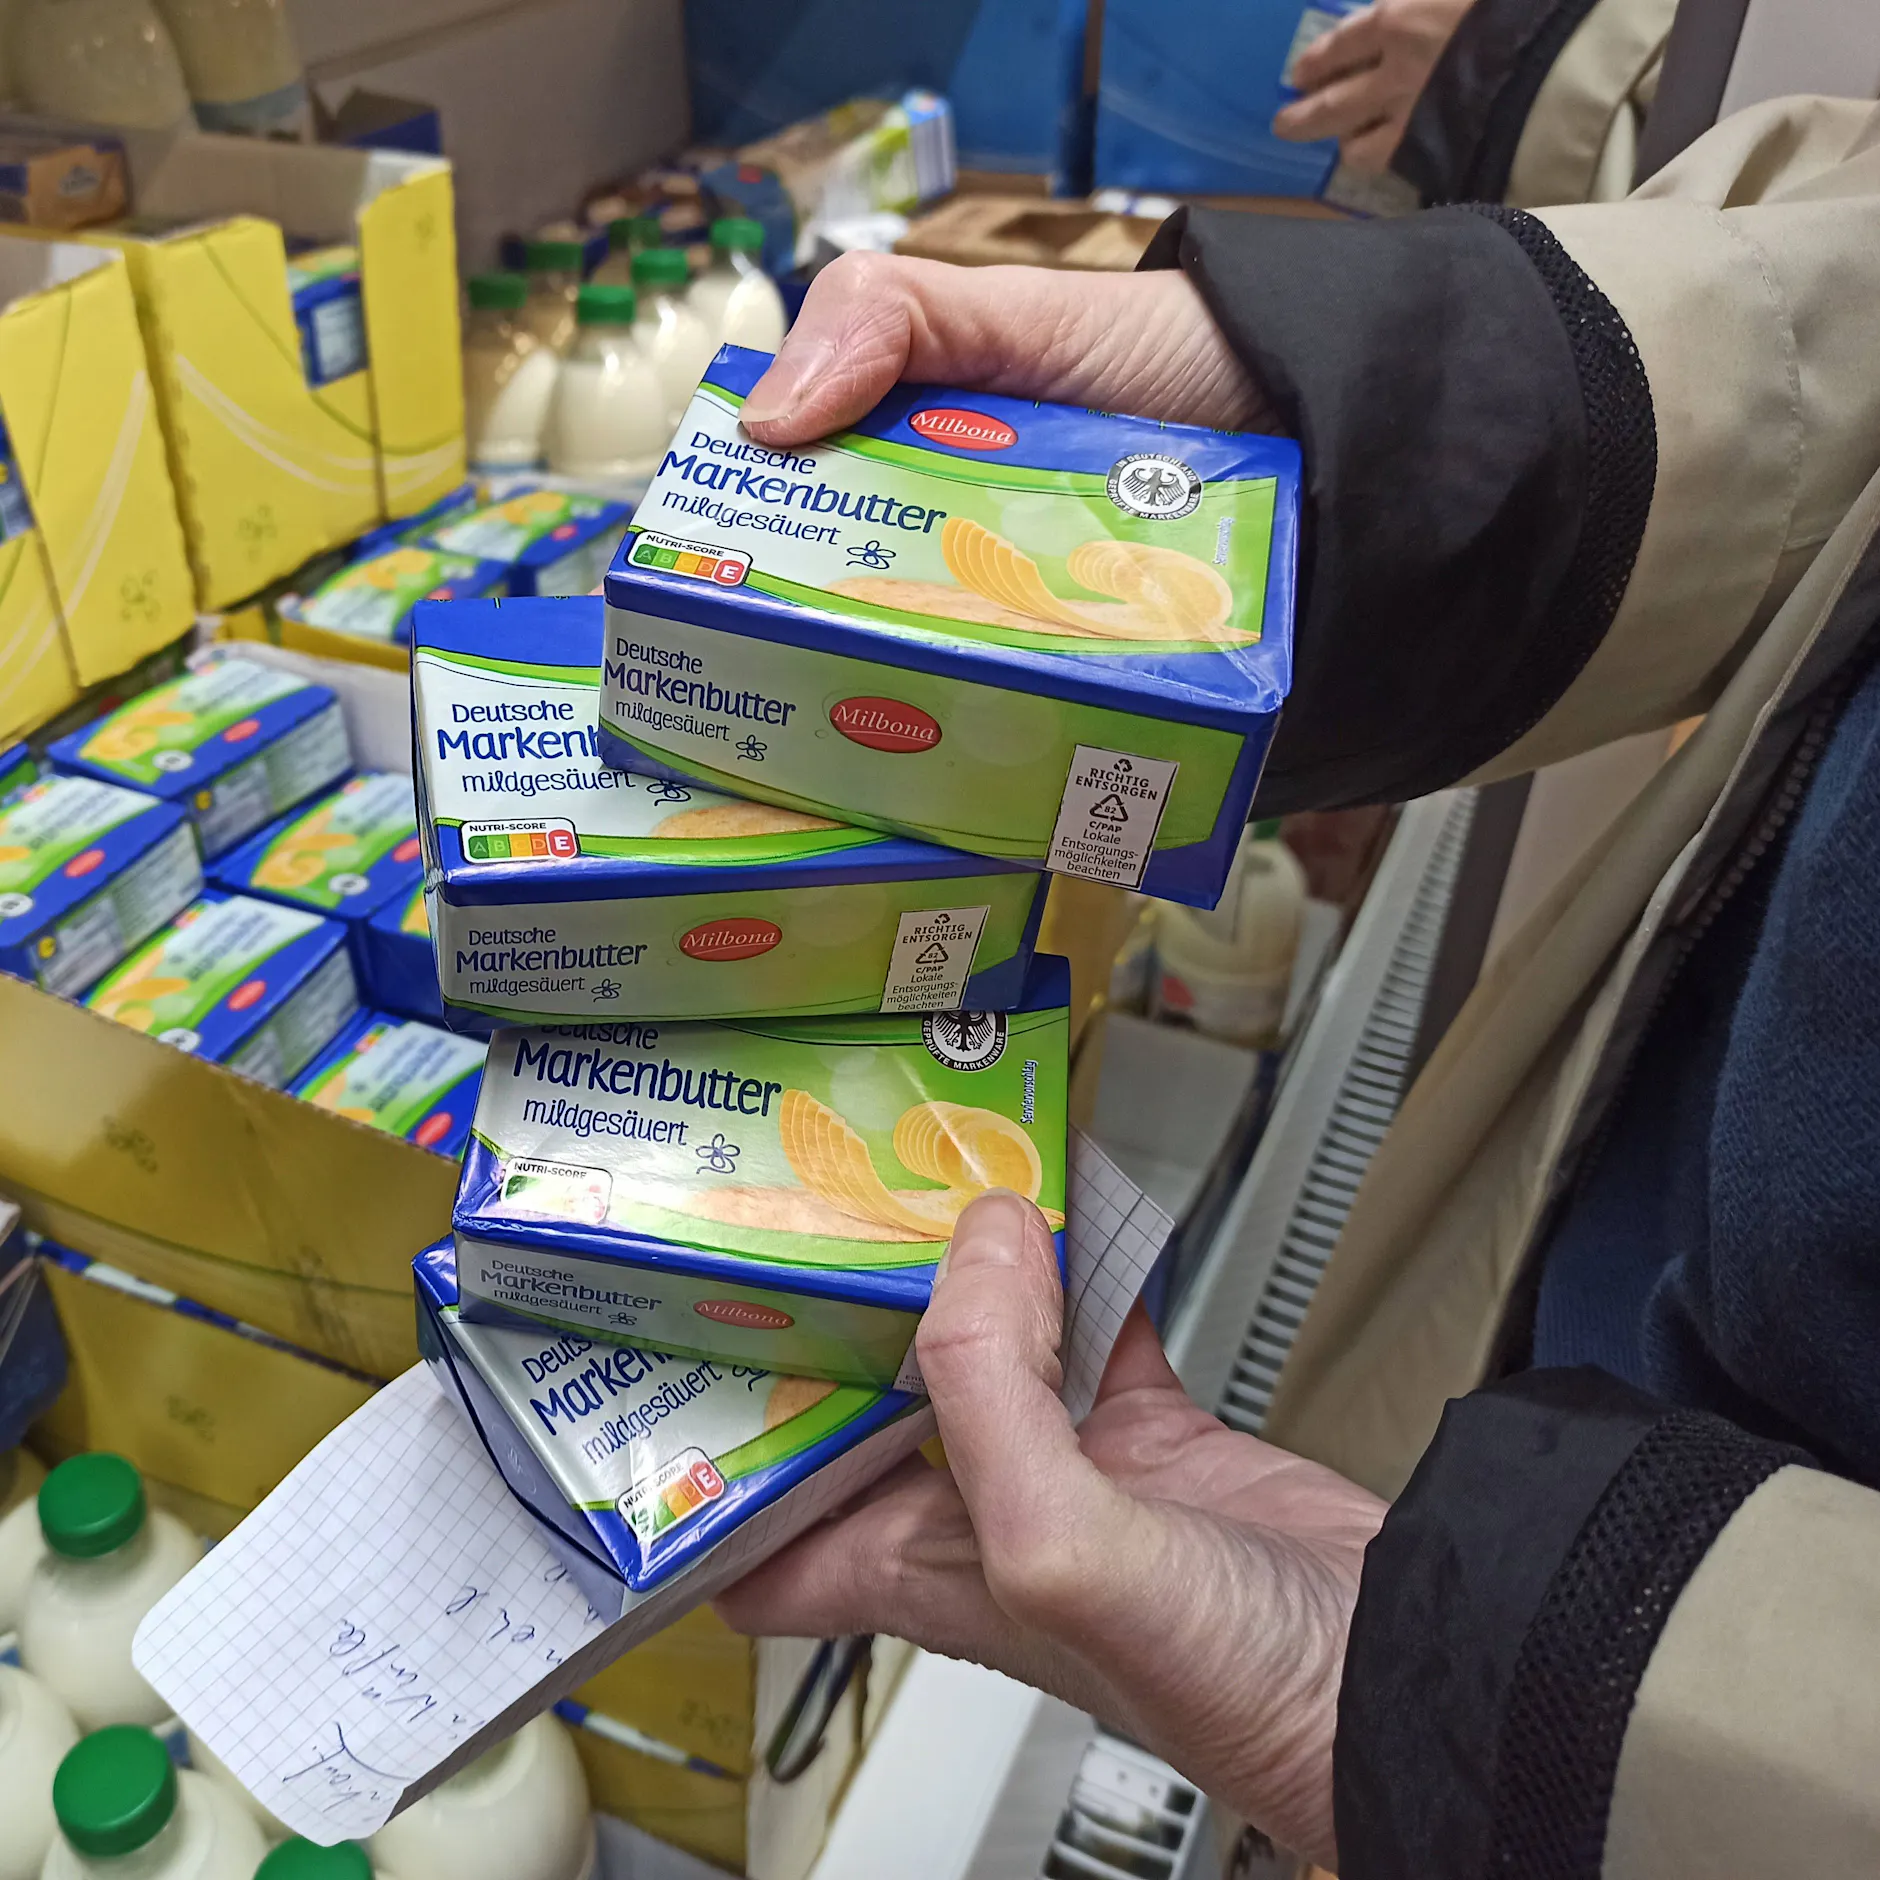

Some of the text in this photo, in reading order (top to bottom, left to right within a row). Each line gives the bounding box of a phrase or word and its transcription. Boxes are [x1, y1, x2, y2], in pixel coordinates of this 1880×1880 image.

[911, 411, 1012, 442] Milbona
[690, 431, 817, 475] Deutsche
[656, 450, 947, 534] Markenbutter
[662, 490, 841, 545] mildgesäuert
[646, 534, 725, 557] NUTRI-SCORE
[720, 564, 740, 580] E
[616, 637, 703, 675] Deutsche
[604, 658, 797, 727] Markenbutter
[452, 700, 574, 723] Deutsche
[615, 700, 730, 742] mildgesäuert
[833, 704, 935, 742] Milbona
[462, 768, 635, 797] mildgesäuert
[1075, 775, 1158, 801] ENTSORGEN
[1090, 767, 1149, 788] RICHTIG
[1104, 805, 1117, 815] 82
[469, 823, 547, 832] NUTRI-SCORE
[1083, 829, 1121, 845] Lokale
[1089, 820, 1122, 833] C/PAP
[554, 836, 570, 851] E
[1061, 837, 1139, 860] Entsorgungs-
[1054, 848, 1137, 871] möglichkeiten
[1067, 861, 1121, 880] beachten
[468, 927, 556, 945] Deutsche
[684, 930, 777, 949] Milbona
[902, 931, 973, 944] ENTSORGEN
[914, 924, 965, 935] RICHTIG
[456, 945, 647, 974] Markenbutter
[915, 965, 944, 974] C/PAP
[469, 977, 586, 996] mildgesäuert
[892, 982, 958, 995] Entsorgungs-
[911, 973, 943, 983] Lokale
[887, 990, 957, 1004] möglichkeiten
[897, 1001, 943, 1011] beachten
[923, 1020, 1004, 1070] GEPRÜFTE MARKENWARE
[513, 1038, 782, 1117] Markenbutter
[523, 1099, 689, 1146] mildgesäuert
[514, 1162, 587, 1180] NUTRI-SCORE
[492, 1259, 574, 1282] Deutsche
[481, 1269, 662, 1311] Markenbutter
[494, 1289, 602, 1315] mildgesäuert
[698, 1302, 787, 1325] Milbona
[530, 1347, 673, 1436] Marken
[582, 1360, 723, 1465] mildgesäuert
[696, 1467, 717, 1491] E
